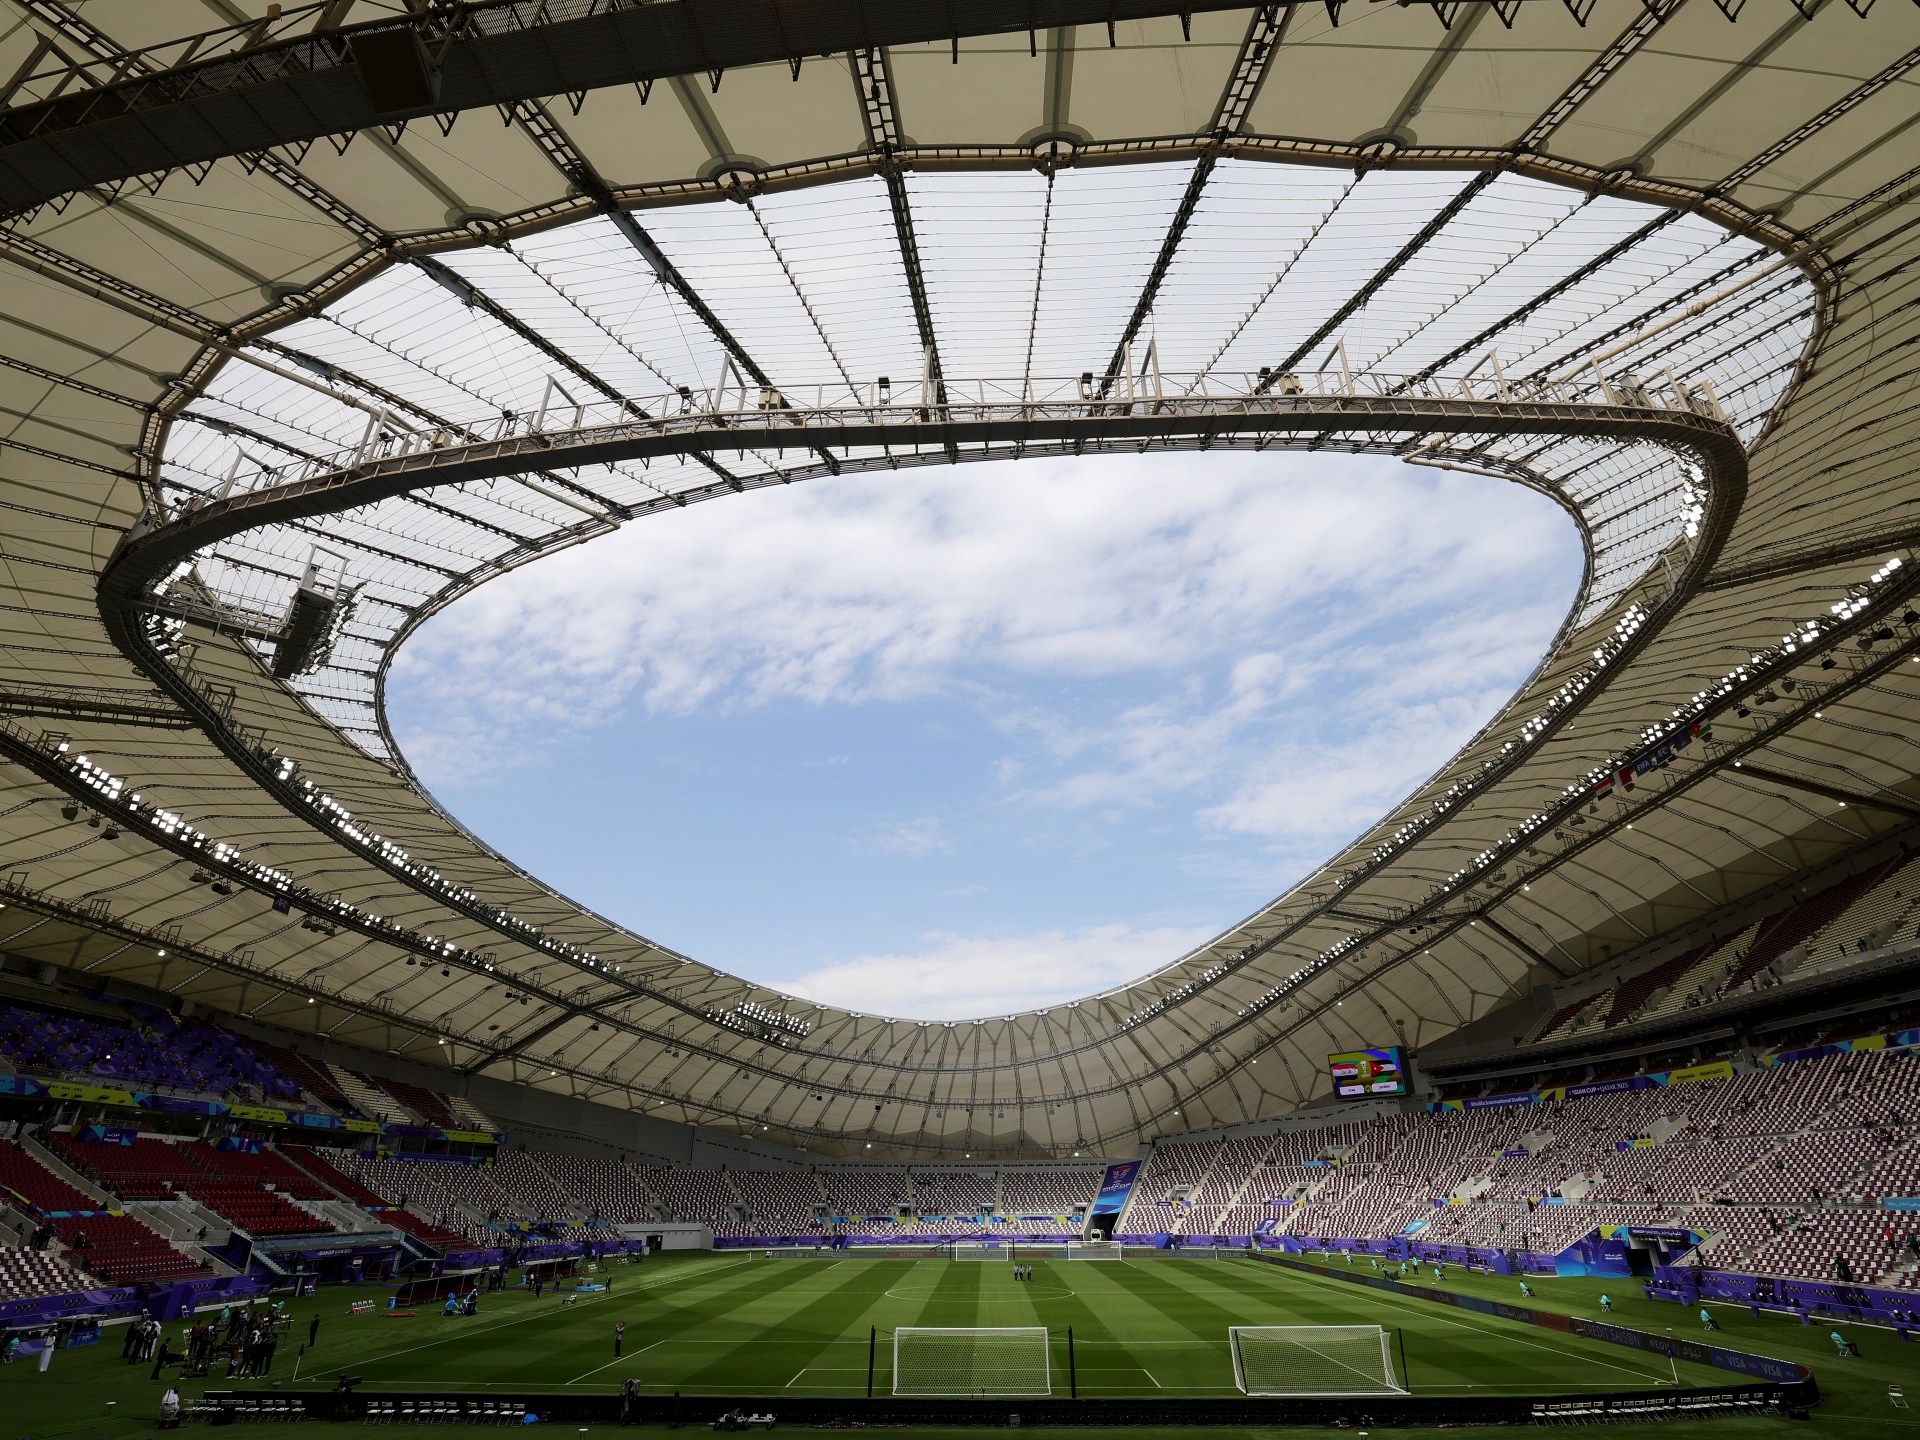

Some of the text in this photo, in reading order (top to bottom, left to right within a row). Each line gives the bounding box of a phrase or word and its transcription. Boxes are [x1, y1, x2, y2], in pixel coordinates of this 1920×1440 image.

[1636, 760, 1650, 771] FIFA
[1600, 1084, 1616, 1092] QATAR
[1584, 1324, 1641, 1346] CREDIT SAISON
[1650, 1339, 1670, 1350] NEOM
[1726, 1354, 1747, 1370] VISA
[1760, 1362, 1783, 1378] VISA
